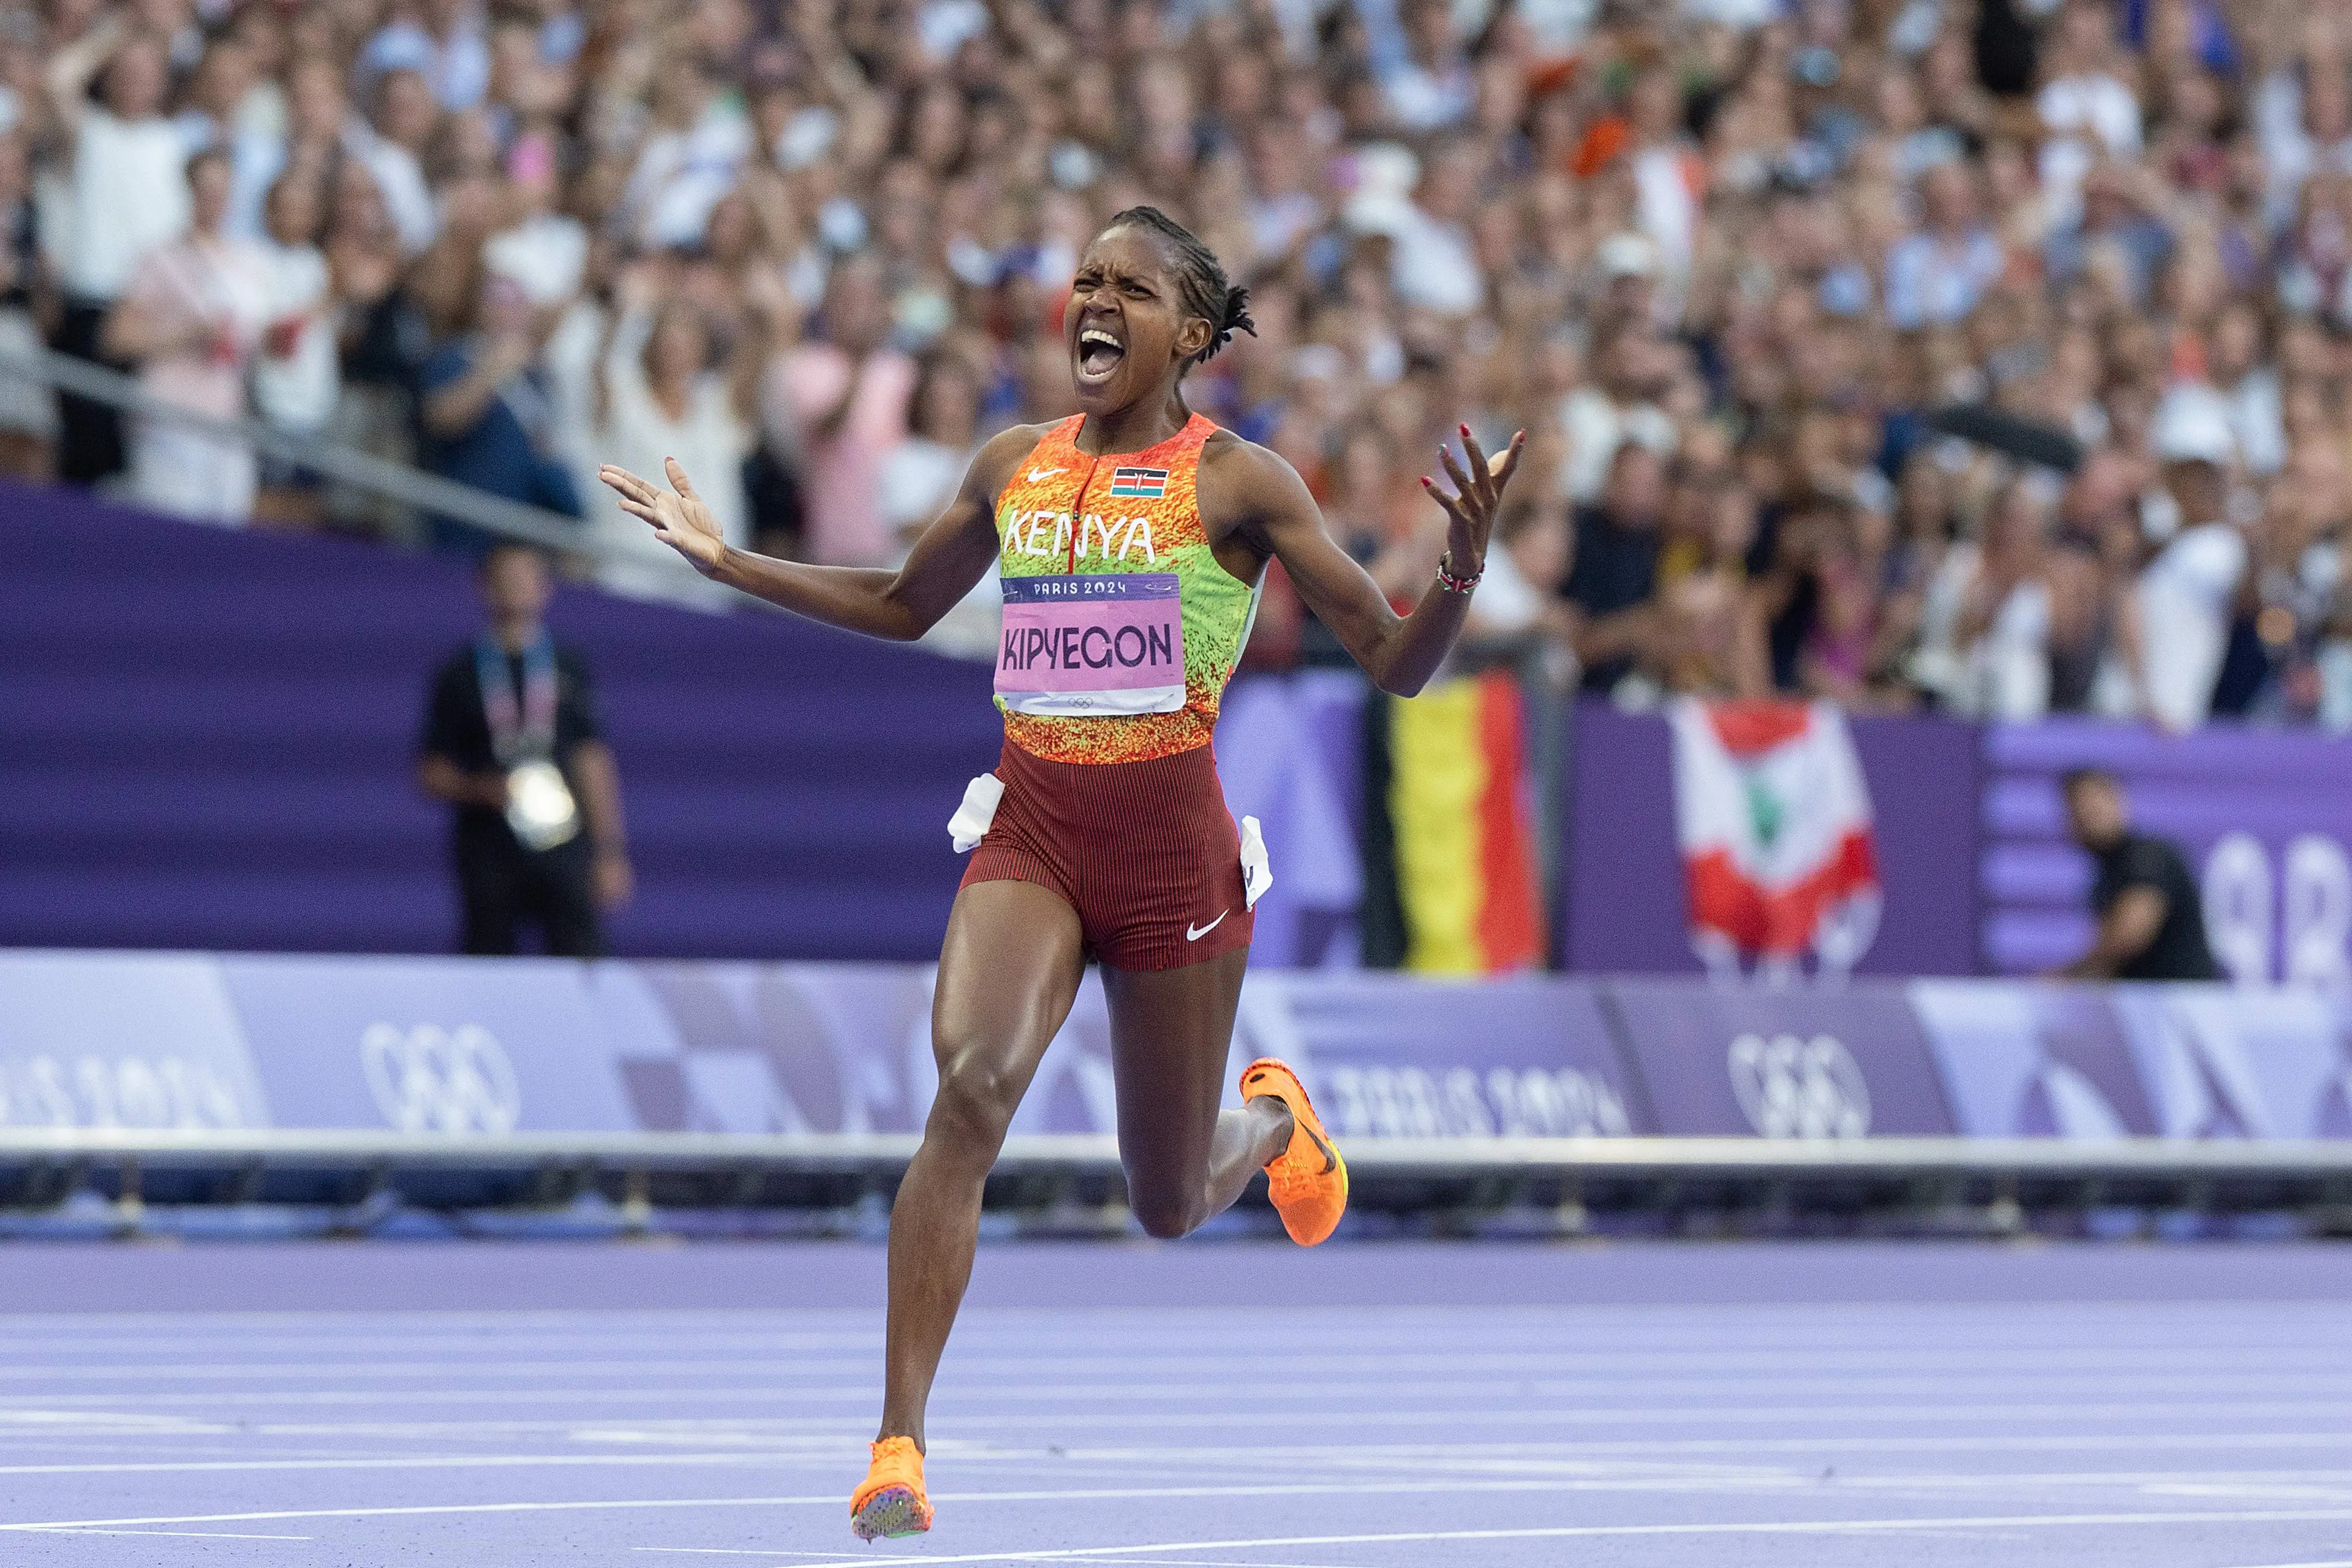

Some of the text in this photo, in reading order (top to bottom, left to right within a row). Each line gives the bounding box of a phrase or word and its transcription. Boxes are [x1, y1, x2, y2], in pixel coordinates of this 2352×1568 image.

[1005, 510, 1155, 564] KENYA
[1035, 582, 1126, 595] PARIS 2024
[1003, 624, 1172, 670] KIPYEGON
